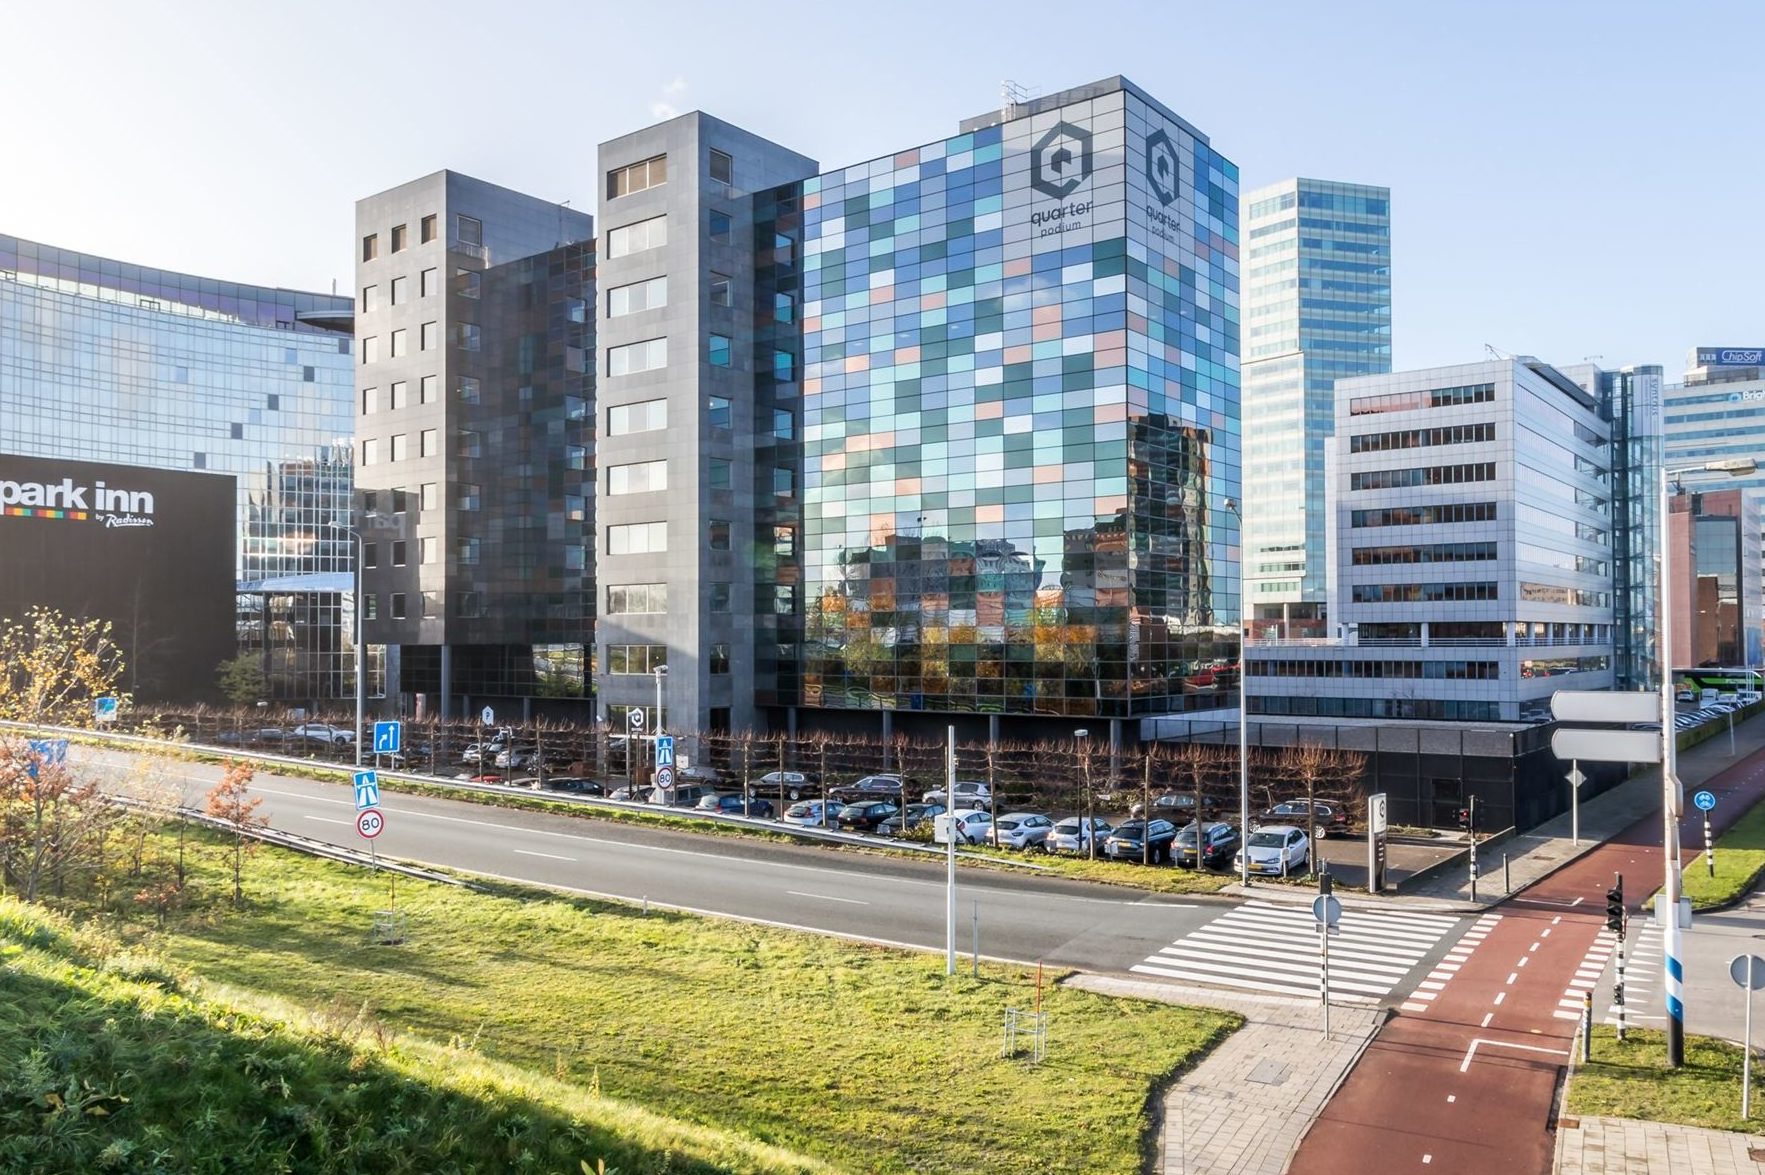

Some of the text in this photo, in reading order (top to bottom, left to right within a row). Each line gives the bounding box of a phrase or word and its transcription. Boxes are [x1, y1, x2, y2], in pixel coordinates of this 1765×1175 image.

[1031, 201, 1093, 227] quarter
[1146, 204, 1180, 233] quarter
[1040, 220, 1082, 239] podium
[1721, 350, 1763, 364] ChipSoft
[0, 478, 154, 515] park inn
[95, 513, 154, 528] by Radisson
[660, 773, 671, 783] 80
[361, 817, 380, 831] 80
